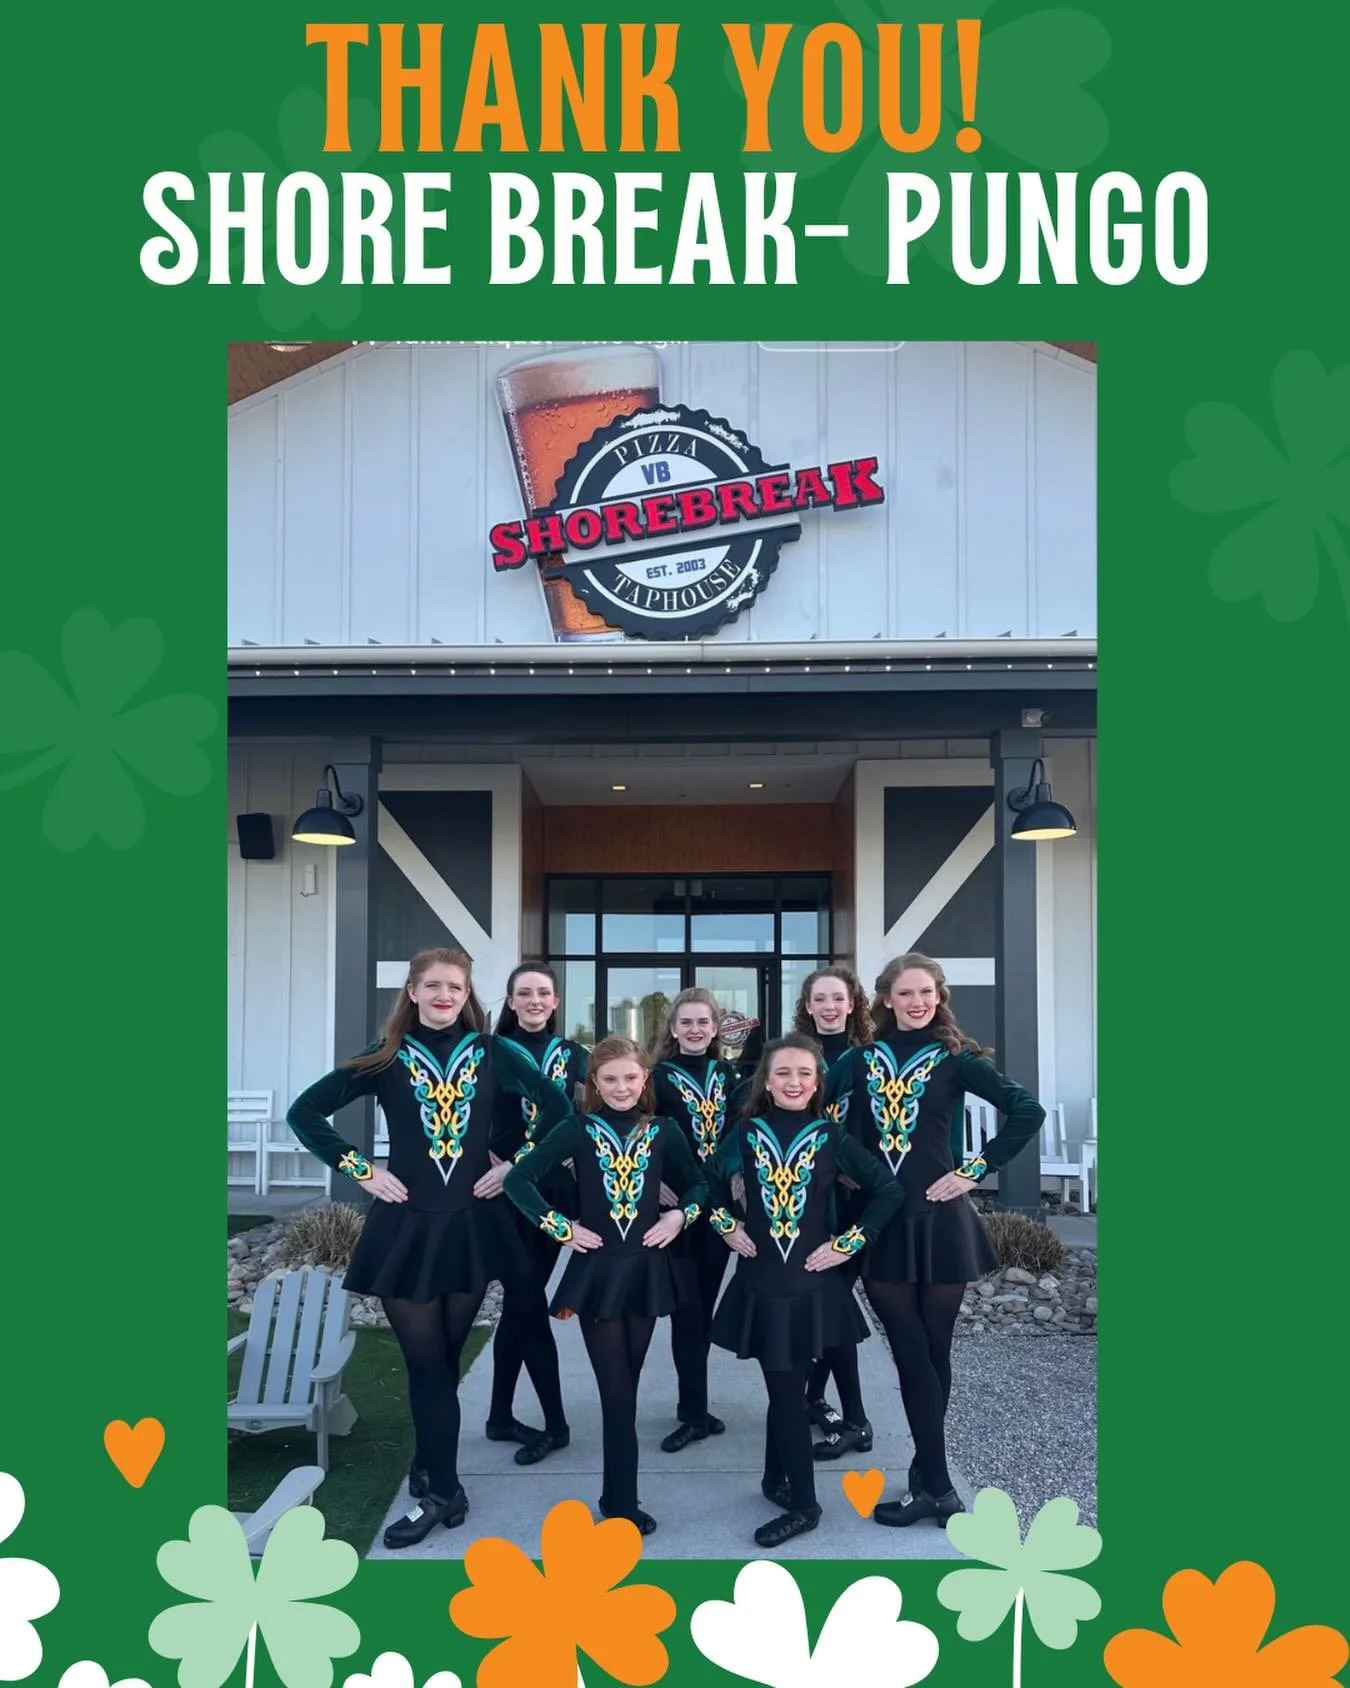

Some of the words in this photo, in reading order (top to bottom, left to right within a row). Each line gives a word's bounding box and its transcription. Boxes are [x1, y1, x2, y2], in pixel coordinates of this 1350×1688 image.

[614, 432, 697, 464] PIZZA
[641, 461, 671, 485] VB
[490, 457, 884, 571] SHOREBREAK
[646, 567, 674, 579] EST.
[677, 558, 706, 573] 2003
[612, 560, 741, 611] TAPHOUSE
